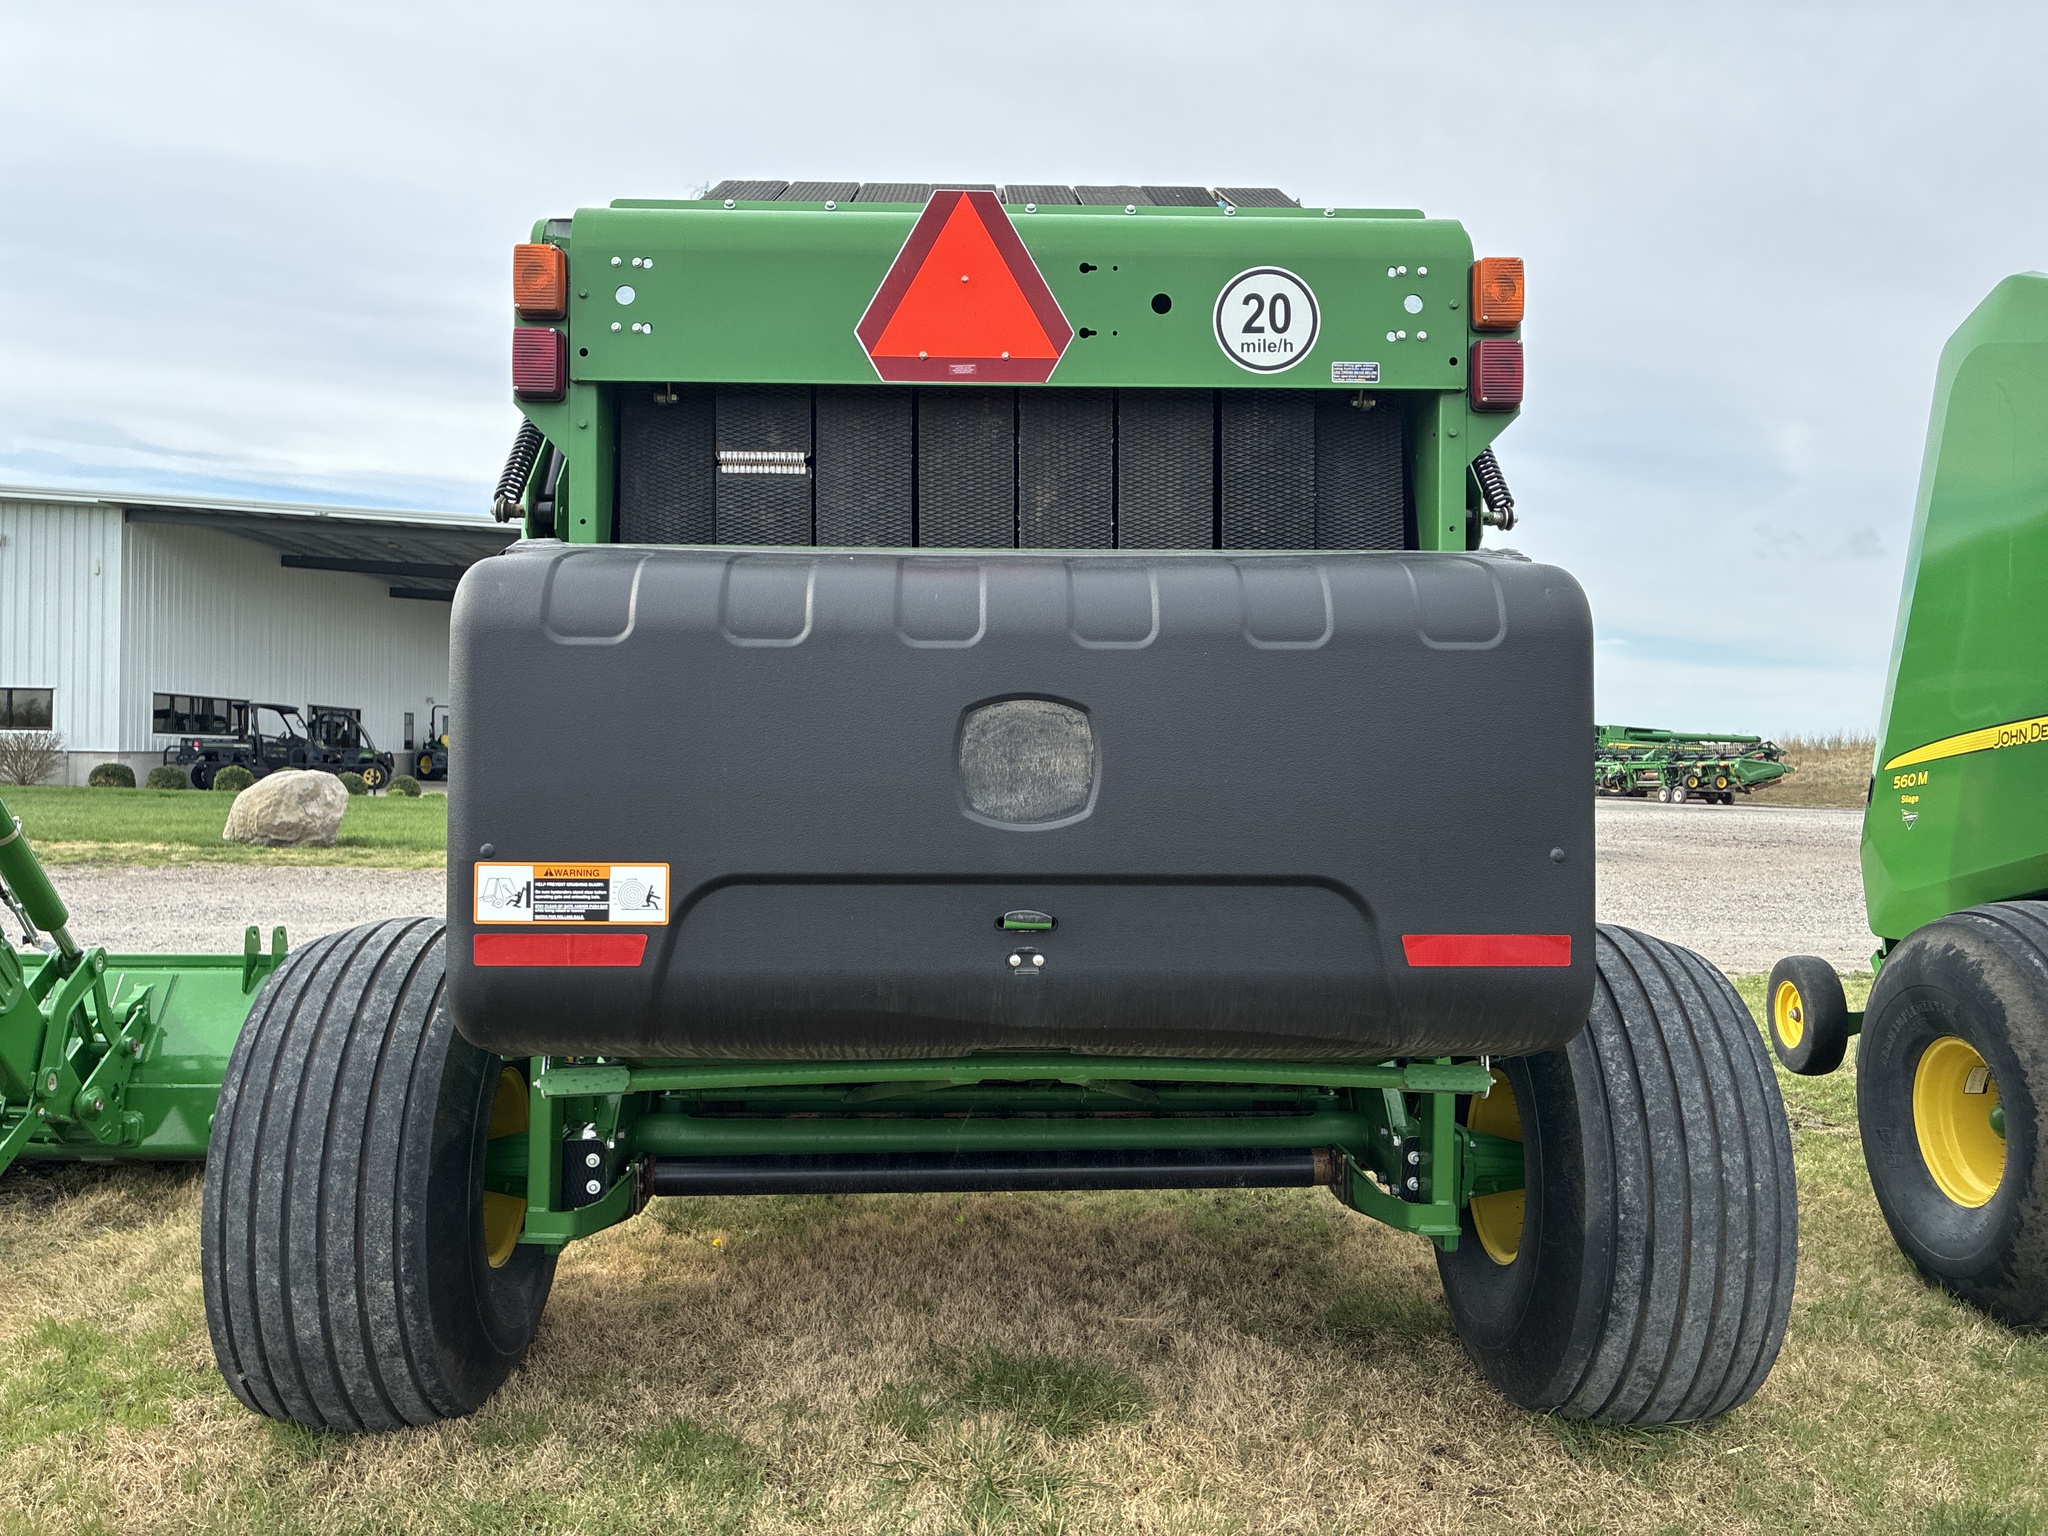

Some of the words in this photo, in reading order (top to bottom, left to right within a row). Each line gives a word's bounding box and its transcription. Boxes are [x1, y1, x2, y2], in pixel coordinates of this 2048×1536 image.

[1242, 292, 1292, 334] 20
[1241, 338, 1294, 353] mile/h
[1994, 728, 2028, 746] JOHN
[1893, 772, 1917, 790] 560
[1917, 770, 1929, 786] M
[554, 869, 600, 877] WARNING
